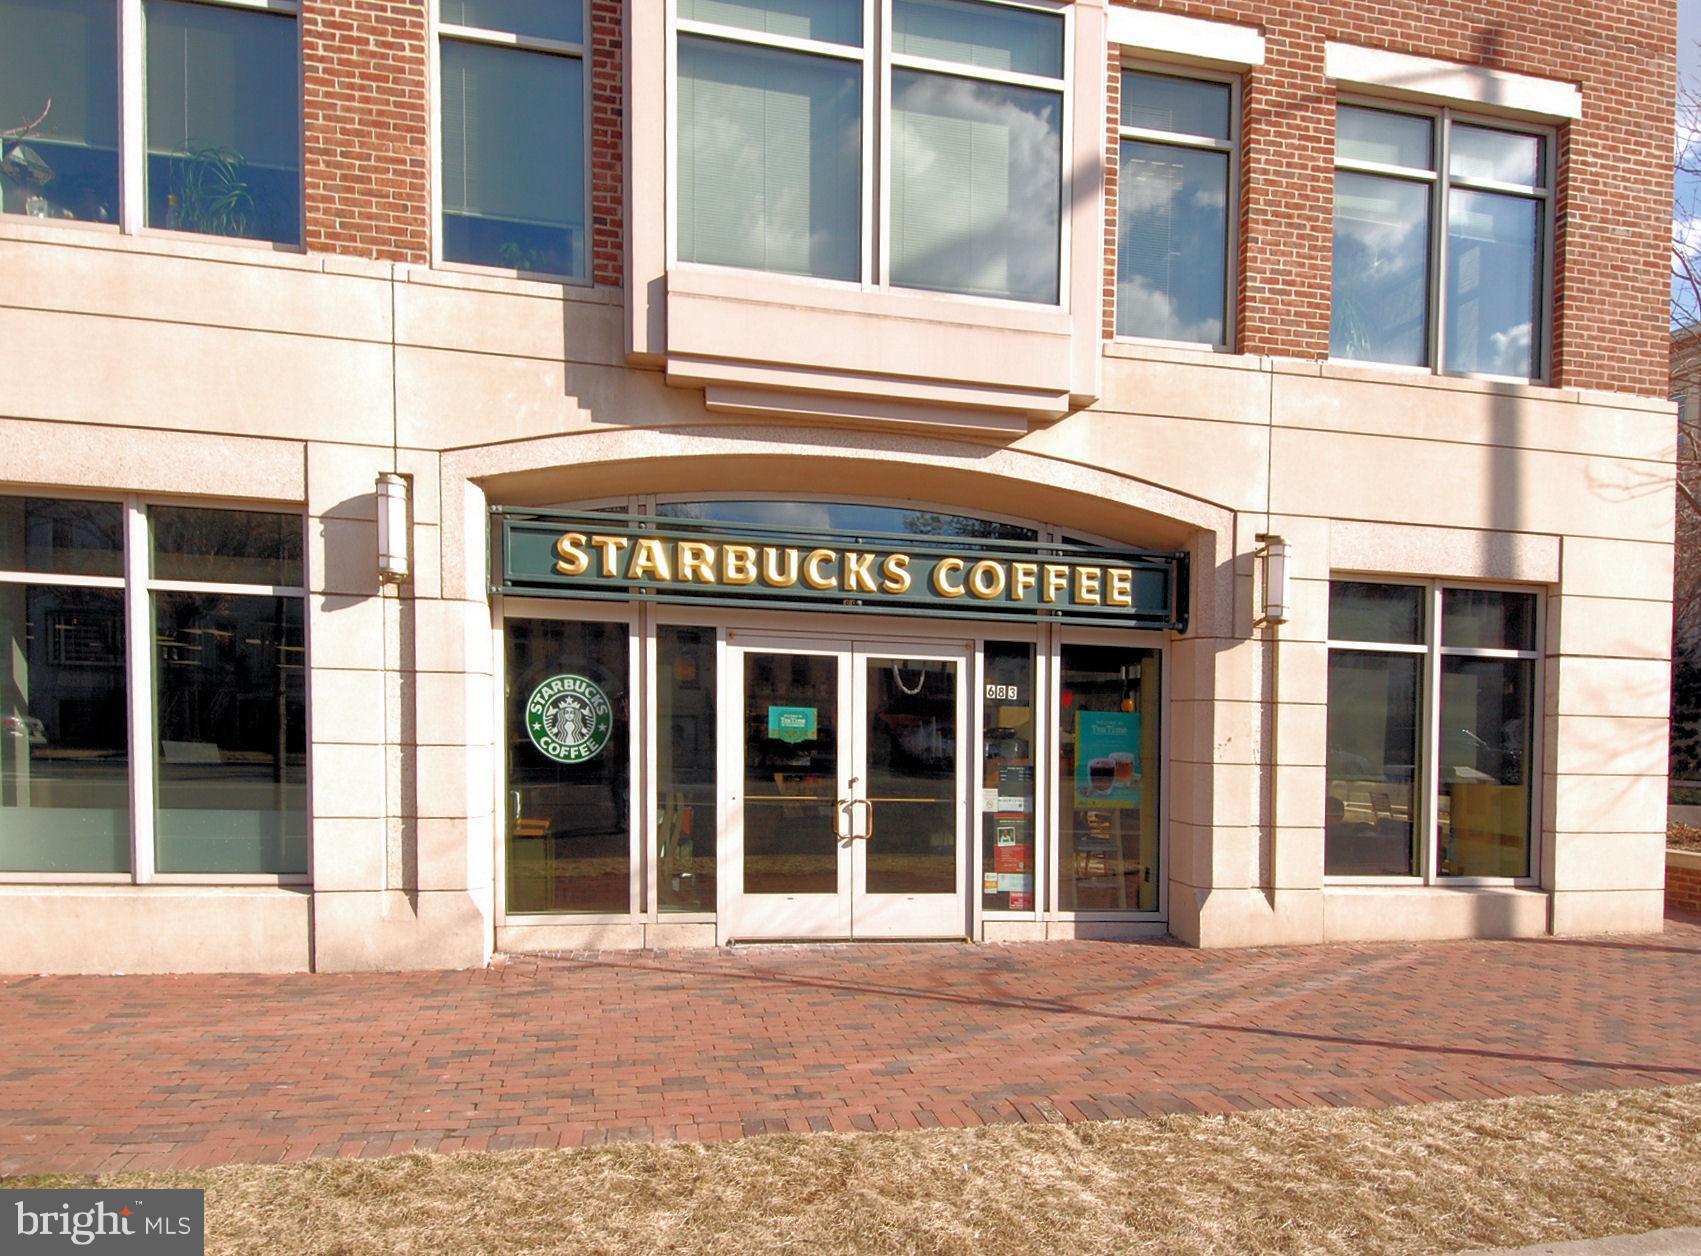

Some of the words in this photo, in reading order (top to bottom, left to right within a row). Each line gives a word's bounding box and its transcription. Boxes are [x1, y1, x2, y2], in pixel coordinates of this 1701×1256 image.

[555, 532, 912, 595] STARBUCKS
[932, 556, 1133, 607] COFFEE
[530, 679, 608, 715] STARBUCKS
[986, 685, 1016, 699] 683
[540, 738, 599, 758] COFFEE
